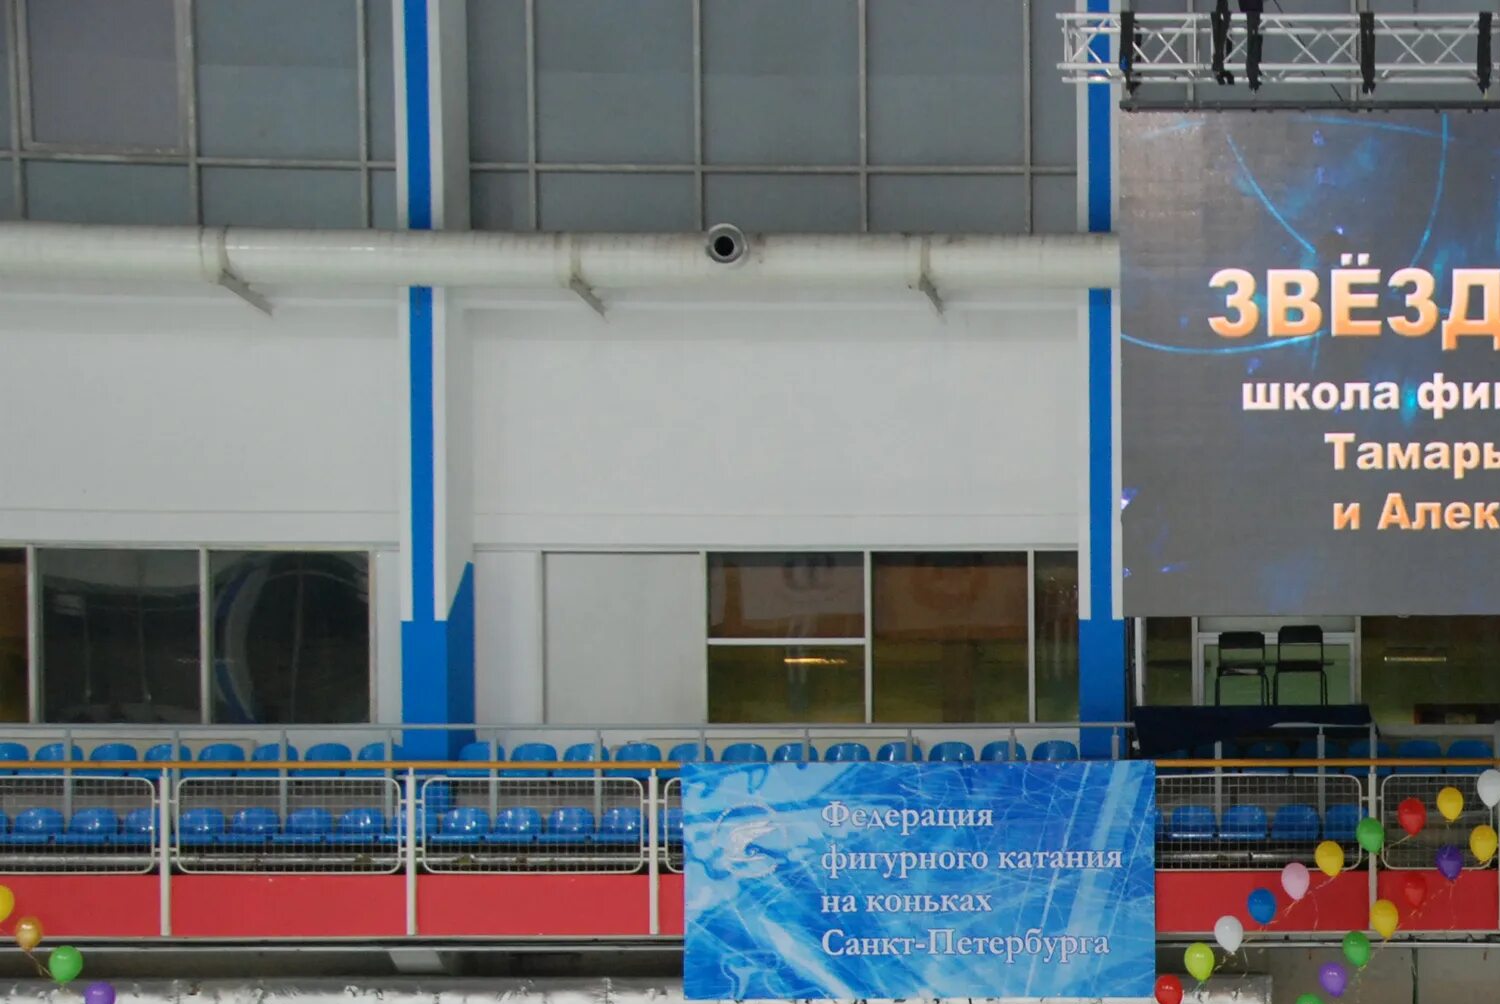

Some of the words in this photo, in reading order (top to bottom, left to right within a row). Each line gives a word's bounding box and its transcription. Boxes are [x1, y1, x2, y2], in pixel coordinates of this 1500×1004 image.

[1242, 380, 1400, 410] школа
[1333, 502, 1360, 530] и
[820, 800, 994, 836] Федерация
[821, 843, 989, 879] фигурного
[998, 850, 1123, 870] катания
[820, 893, 858, 914] на
[865, 892, 993, 913] коньках
[821, 928, 1111, 964] Санкт-Петербурга
